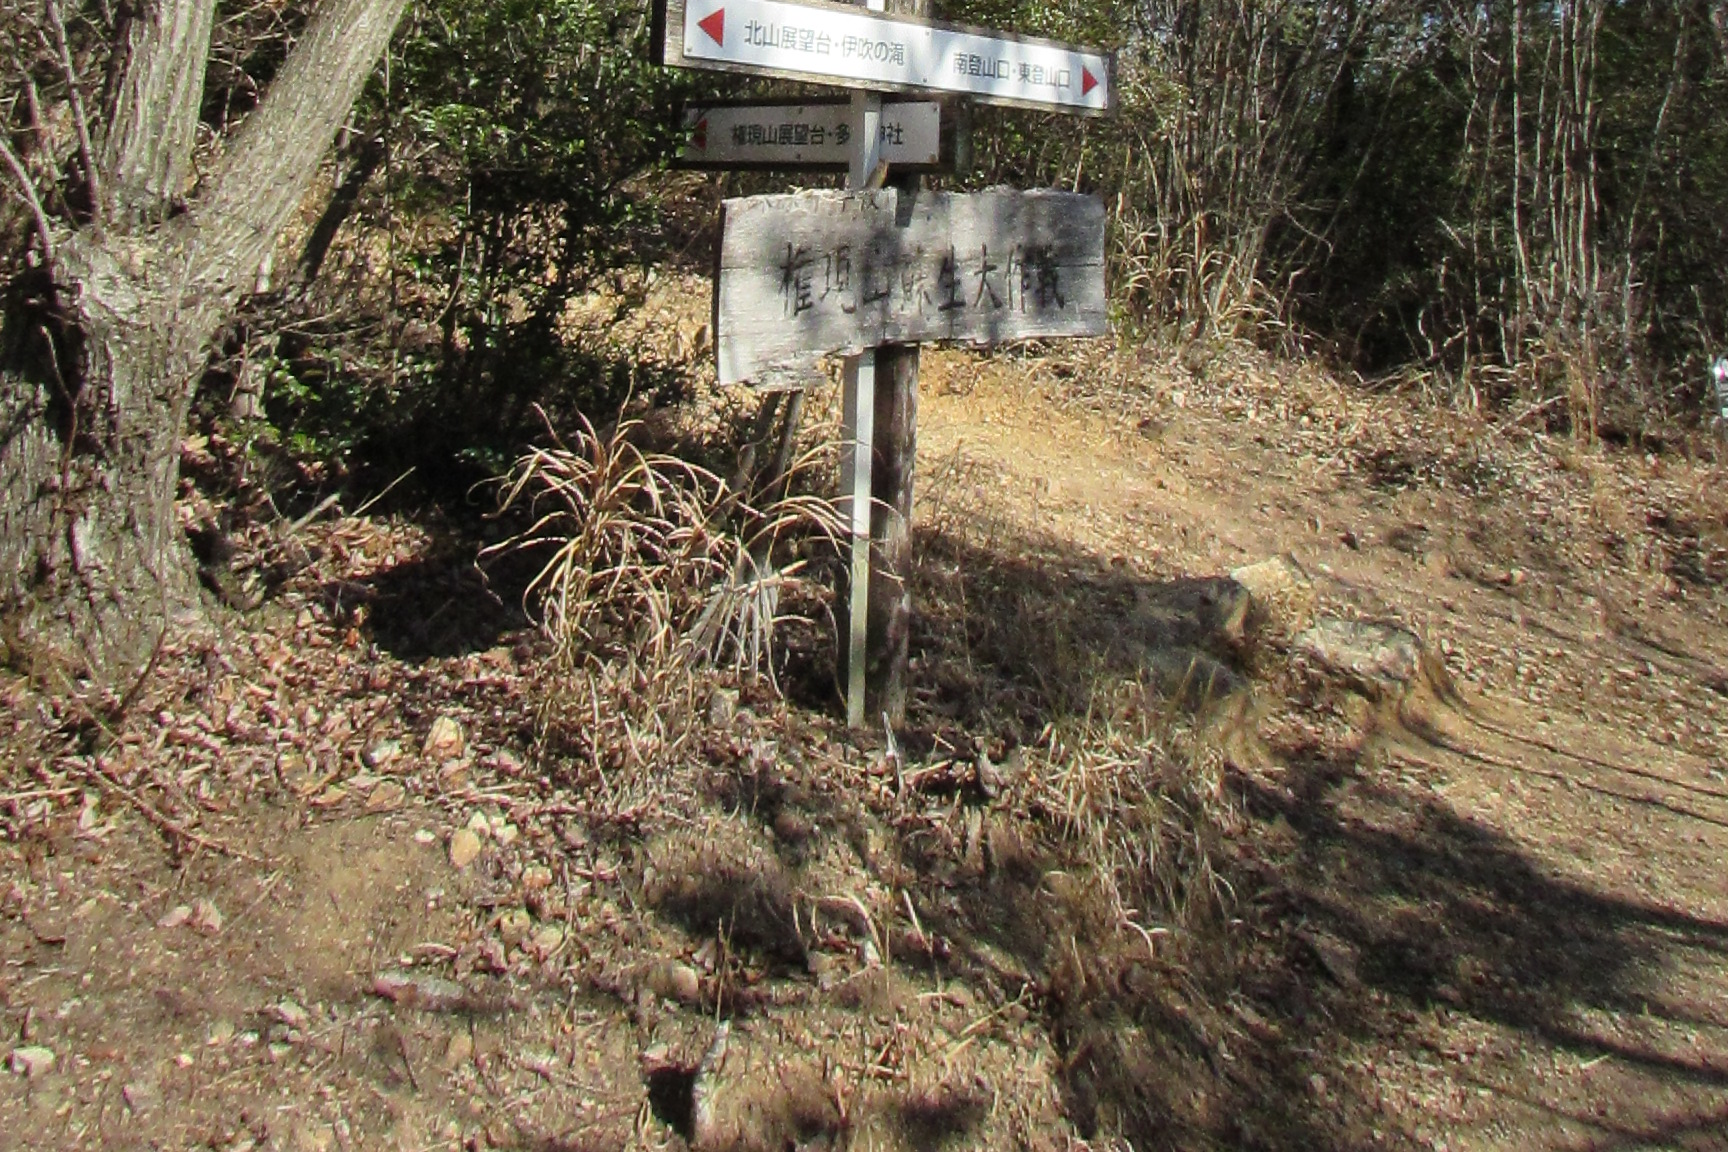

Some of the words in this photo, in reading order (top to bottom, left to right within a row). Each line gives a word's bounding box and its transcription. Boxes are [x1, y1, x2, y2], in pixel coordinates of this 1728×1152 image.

[744, 19, 905, 66] 北山展望台・伊吹の滝
[953, 51, 1071, 88] 南登山口・東登山口
